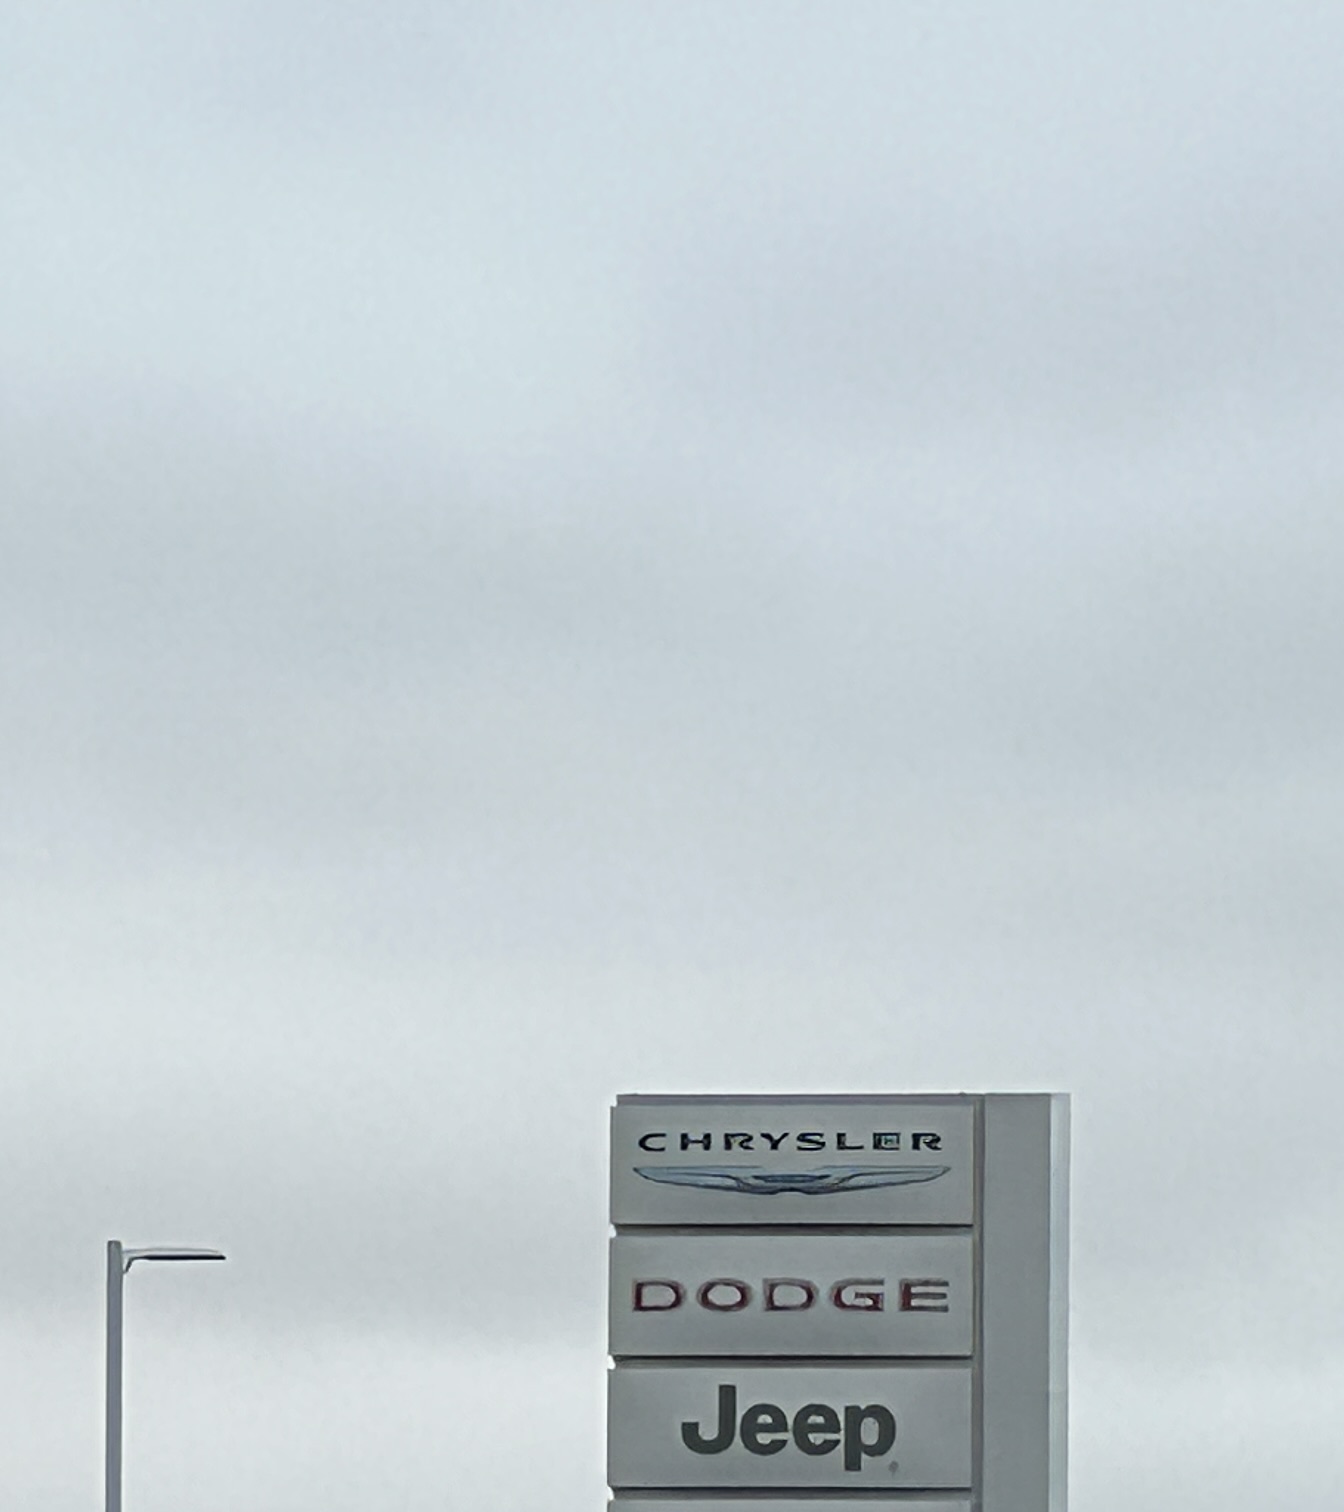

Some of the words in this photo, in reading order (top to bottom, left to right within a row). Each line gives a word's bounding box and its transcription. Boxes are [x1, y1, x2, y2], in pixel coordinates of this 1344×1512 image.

[638, 1132, 943, 1152] CHRYSLER
[632, 1278, 950, 1312] DODGE
[681, 1384, 897, 1471] Jeep
